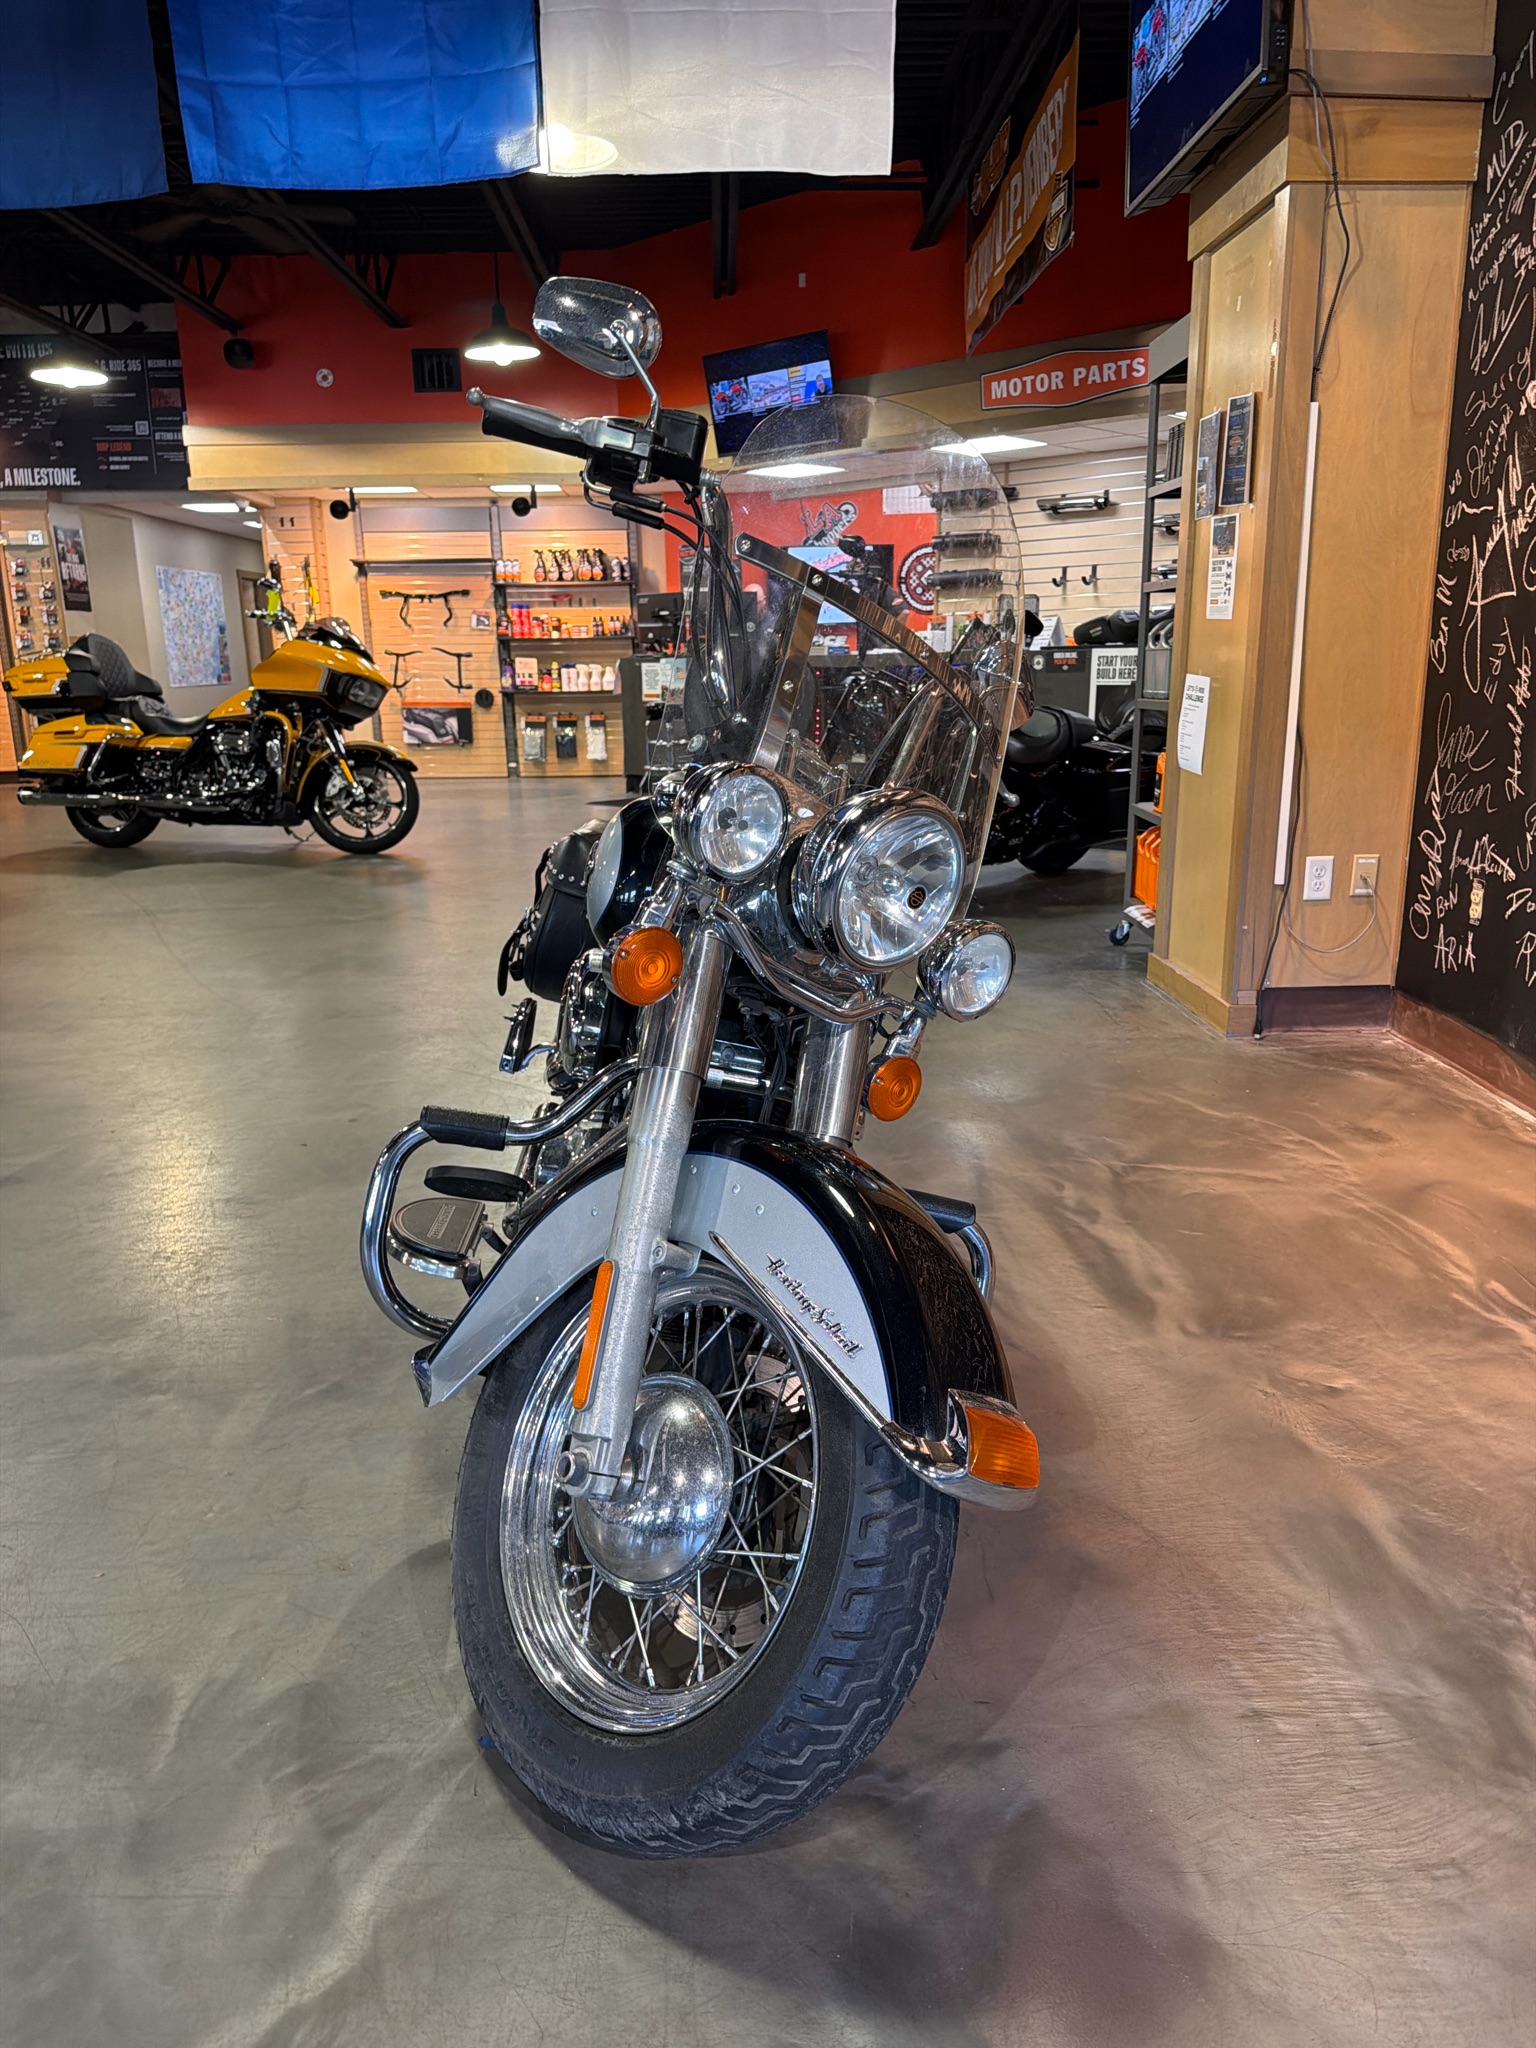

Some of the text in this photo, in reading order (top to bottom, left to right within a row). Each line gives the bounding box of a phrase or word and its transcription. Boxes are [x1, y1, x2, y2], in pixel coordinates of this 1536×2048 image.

[109, 359, 126, 371] RIDE
[127, 359, 142, 371] 365
[991, 357, 1147, 400] MOTOR PARTS
[4, 467, 81, 487] A MILESTONE.
[1097, 655, 1138, 667] START YOUR
[1096, 667, 1137, 680] BUILD HERE
